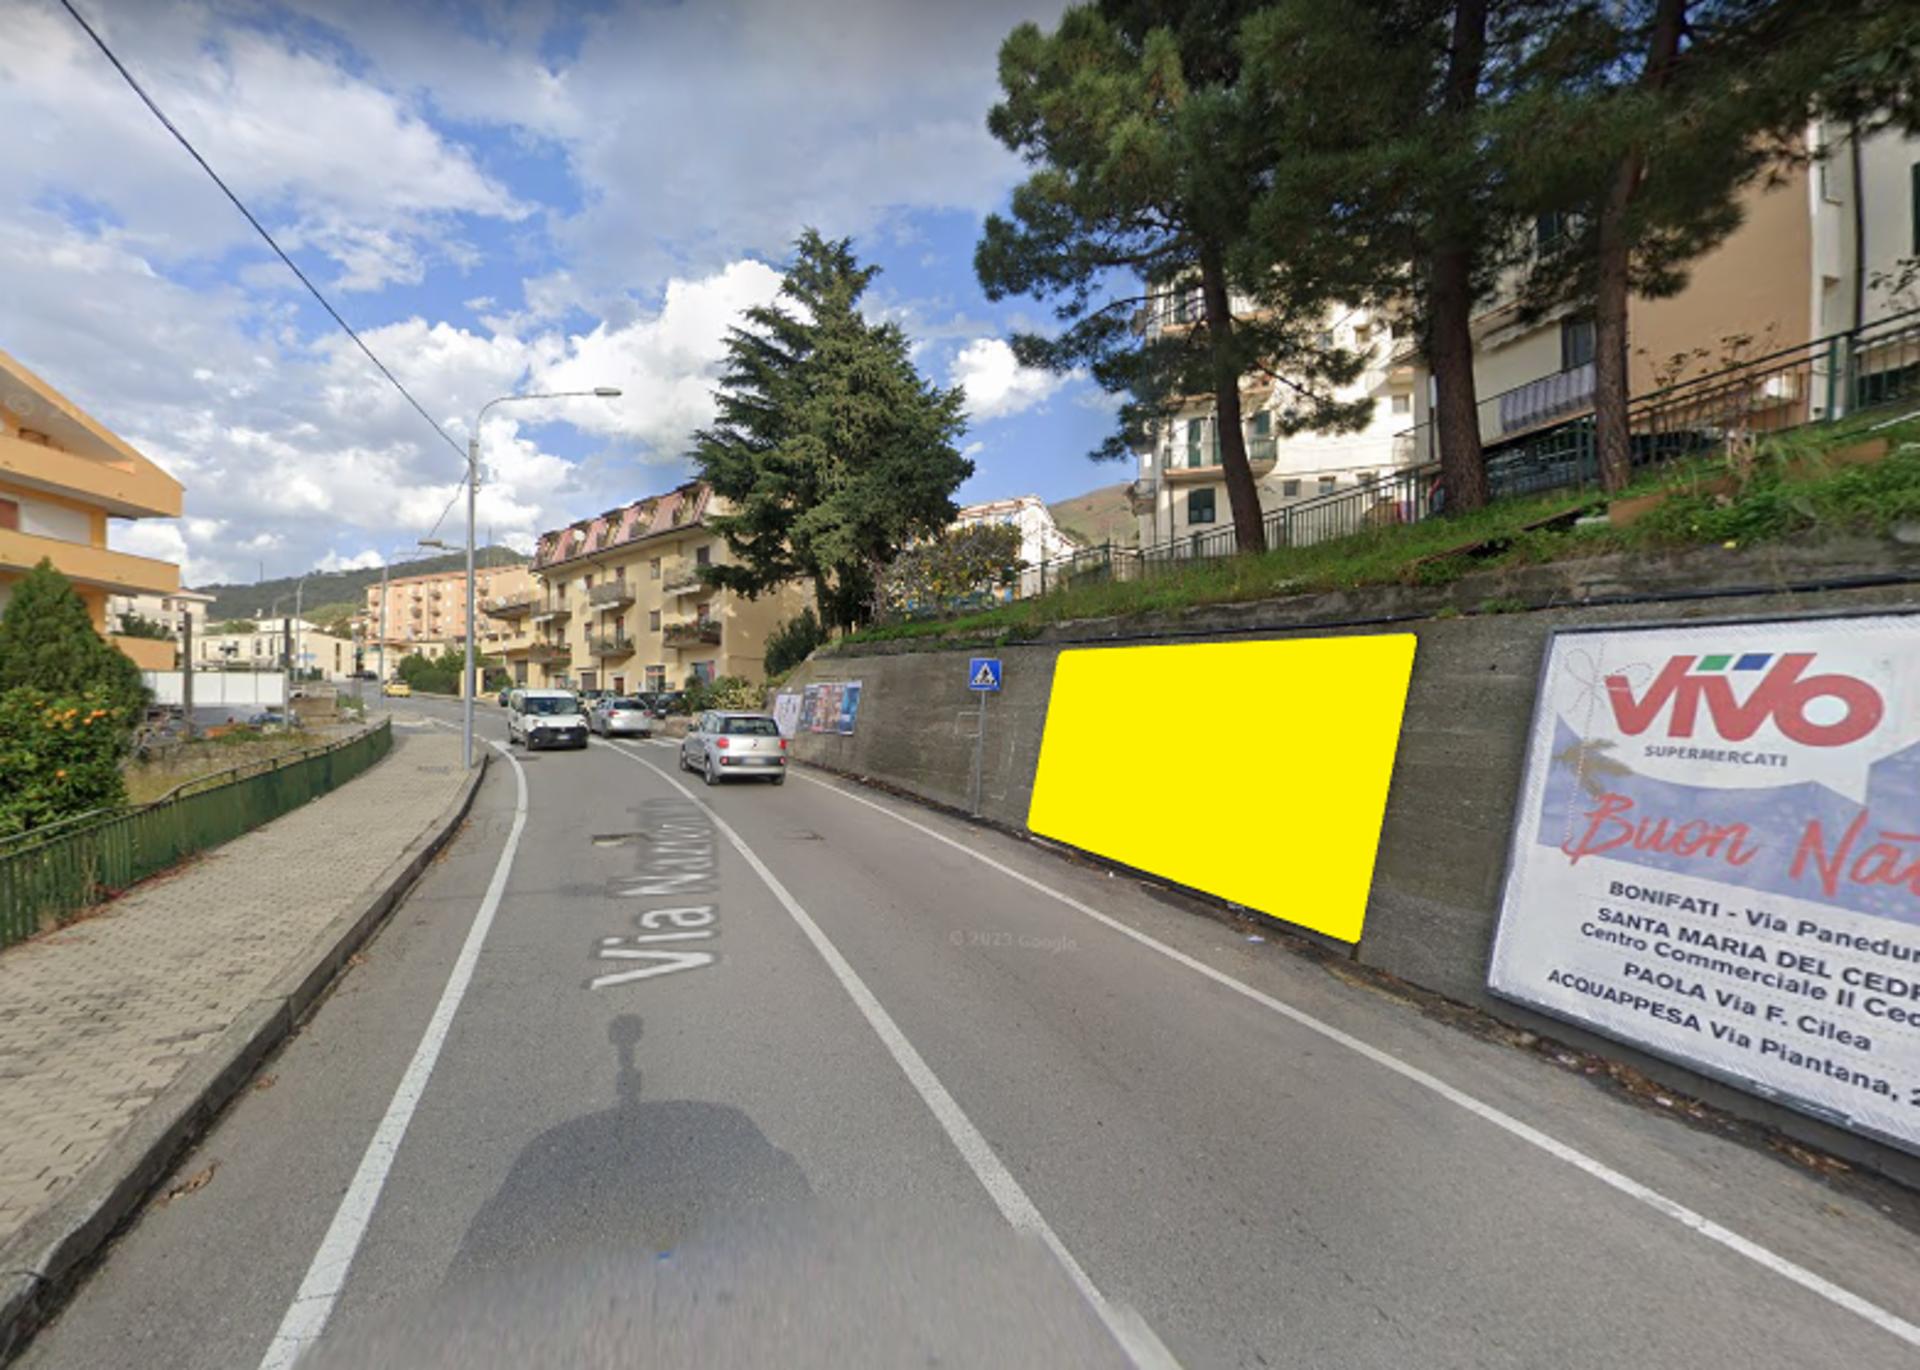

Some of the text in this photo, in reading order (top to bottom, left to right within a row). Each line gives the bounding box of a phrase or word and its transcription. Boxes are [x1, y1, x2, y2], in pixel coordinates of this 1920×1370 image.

[1645, 745, 1788, 767] SUPERMERCATI
[1562, 792, 1760, 866] Buon
[1598, 907, 1670, 938] SANTA
[1678, 927, 1767, 962] MARIA
[1777, 951, 1832, 980] DEL
[1609, 881, 1719, 917] BONIFATI
[1746, 909, 1787, 933] Via
[1581, 922, 1647, 952] Centro
[1654, 942, 1828, 1000] Commerciale
[1548, 969, 1701, 1032] ACQUAPPESA
[1711, 1021, 1752, 1048] Via
[1760, 1038, 1898, 1101] Piantana,
[1624, 962, 1872, 1051] PAOLA Via F. Cilea
